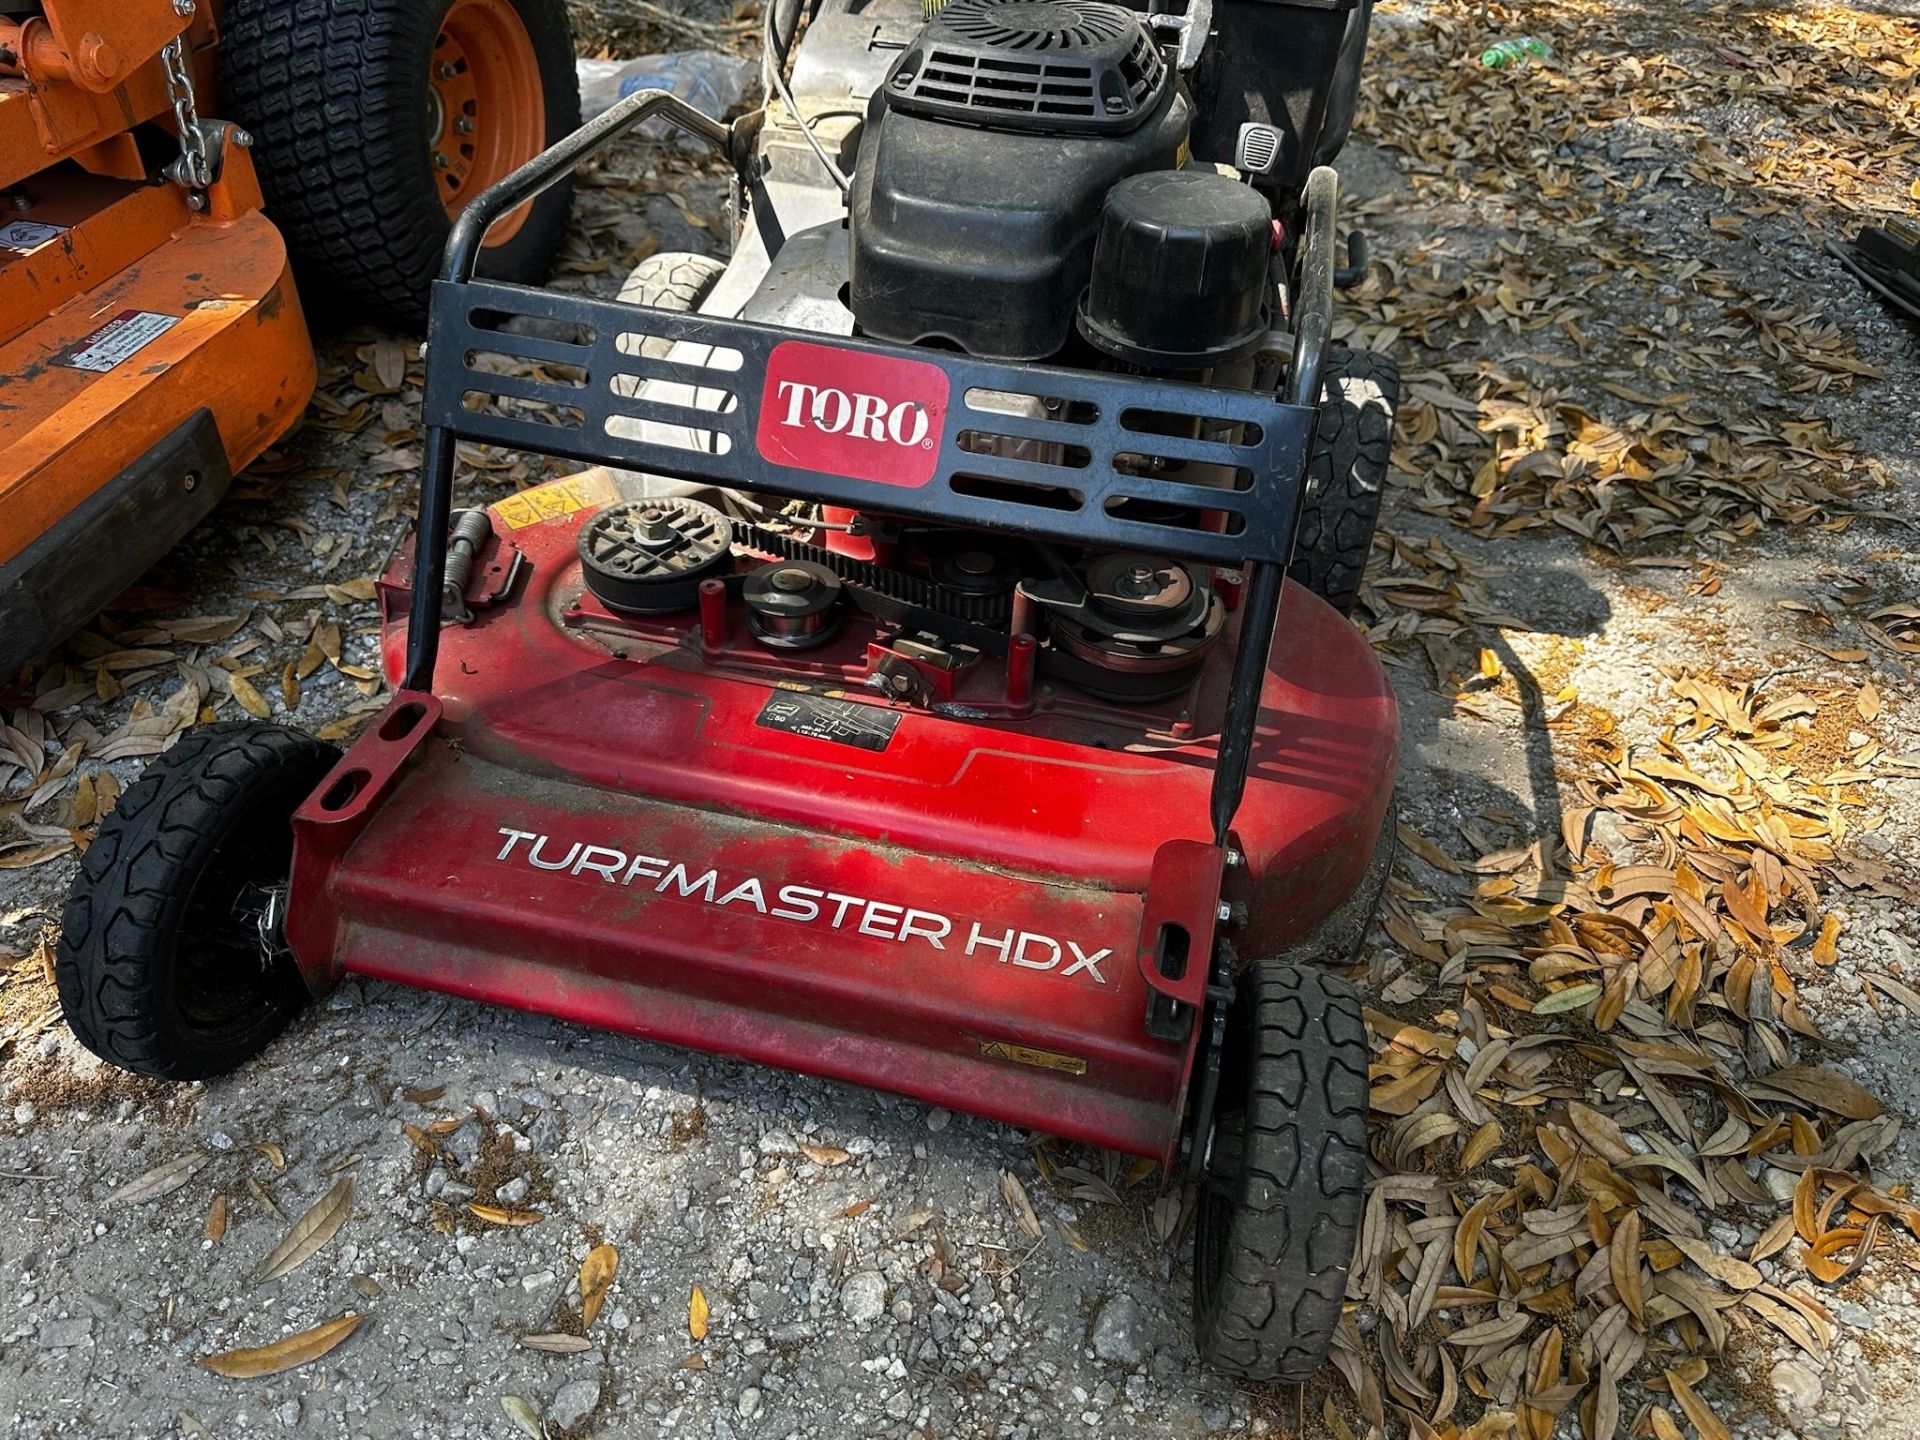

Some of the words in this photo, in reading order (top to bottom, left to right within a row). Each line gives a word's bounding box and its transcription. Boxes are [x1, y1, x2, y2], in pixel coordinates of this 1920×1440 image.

[777, 381, 929, 446] TORO
[496, 827, 952, 950] TURFMASTER
[964, 921, 1113, 984] HDX
